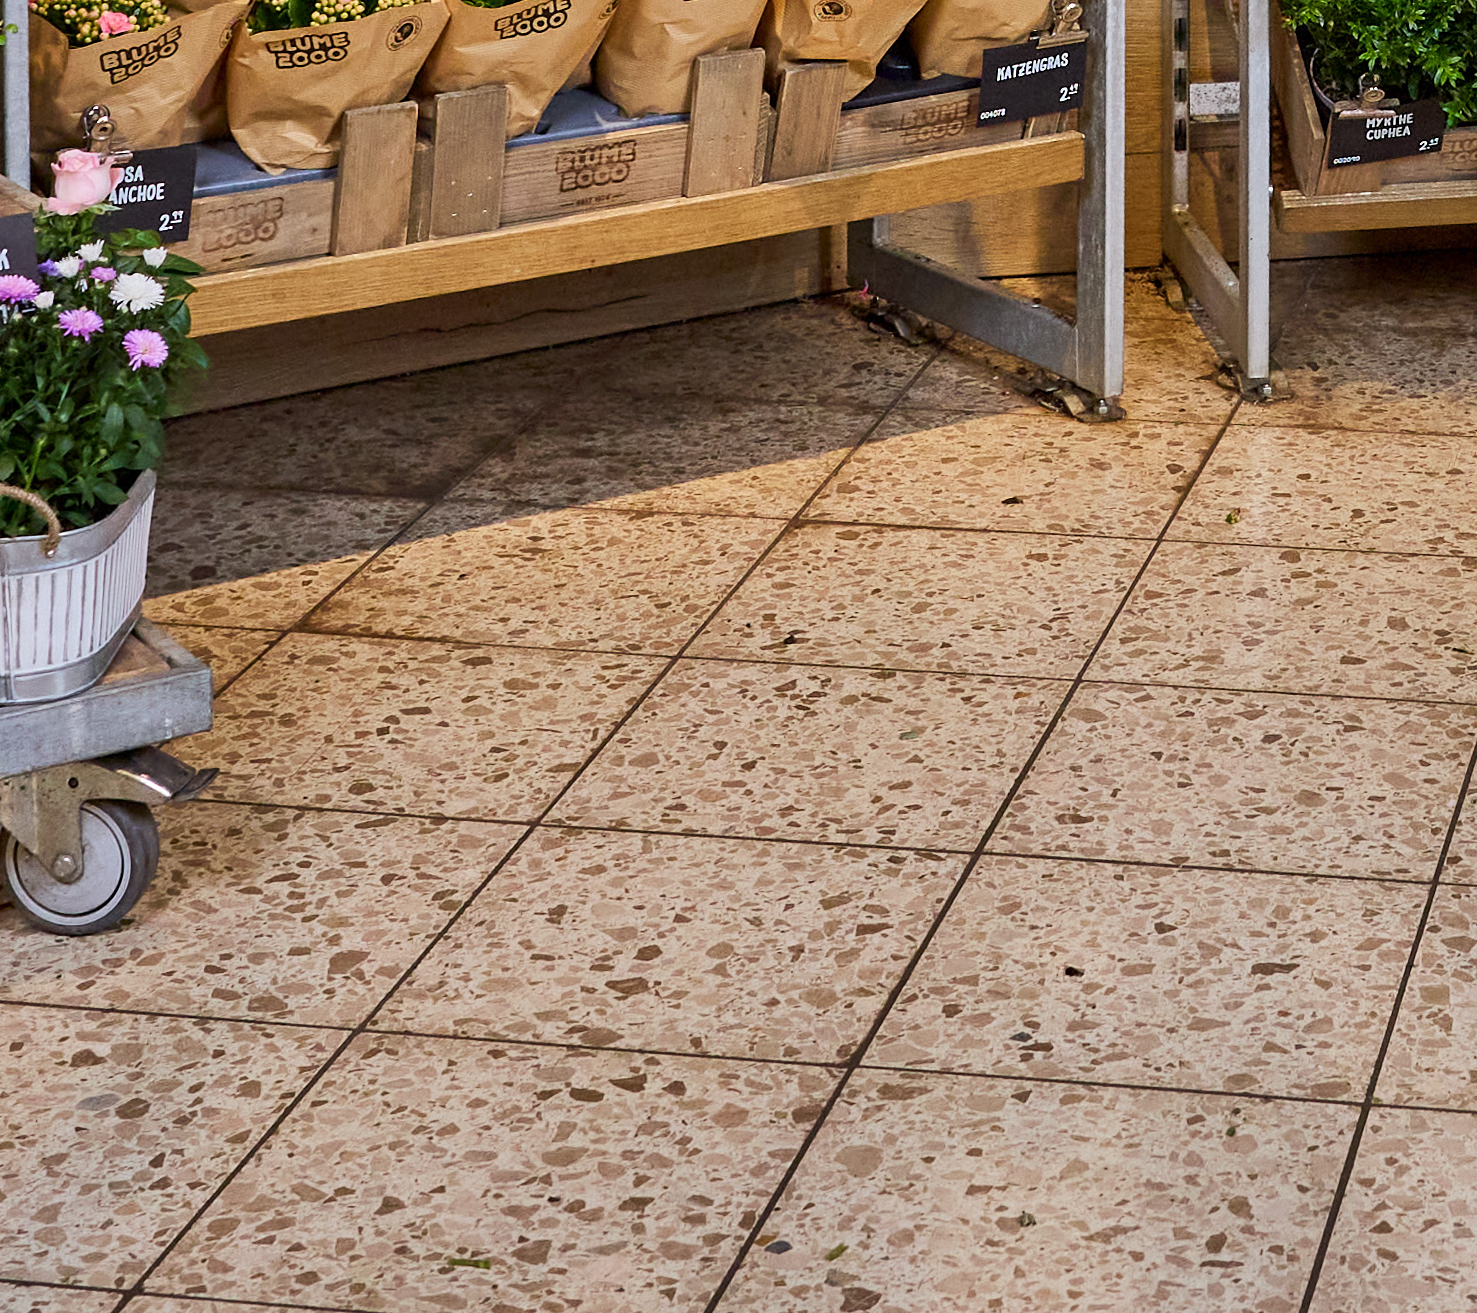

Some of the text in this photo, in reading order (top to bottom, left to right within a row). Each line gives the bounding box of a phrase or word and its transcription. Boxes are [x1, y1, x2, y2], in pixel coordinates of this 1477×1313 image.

[499, 9, 569, 39] 2000
[100, 27, 181, 72] BLUME
[267, 32, 350, 54] BLUME
[110, 44, 180, 84] 2000
[277, 46, 349, 69] 2000
[996, 53, 1069, 81] KATZENGRAS
[1365, 113, 1414, 129] MYRTHE
[1365, 126, 1411, 141] CUPHEA
